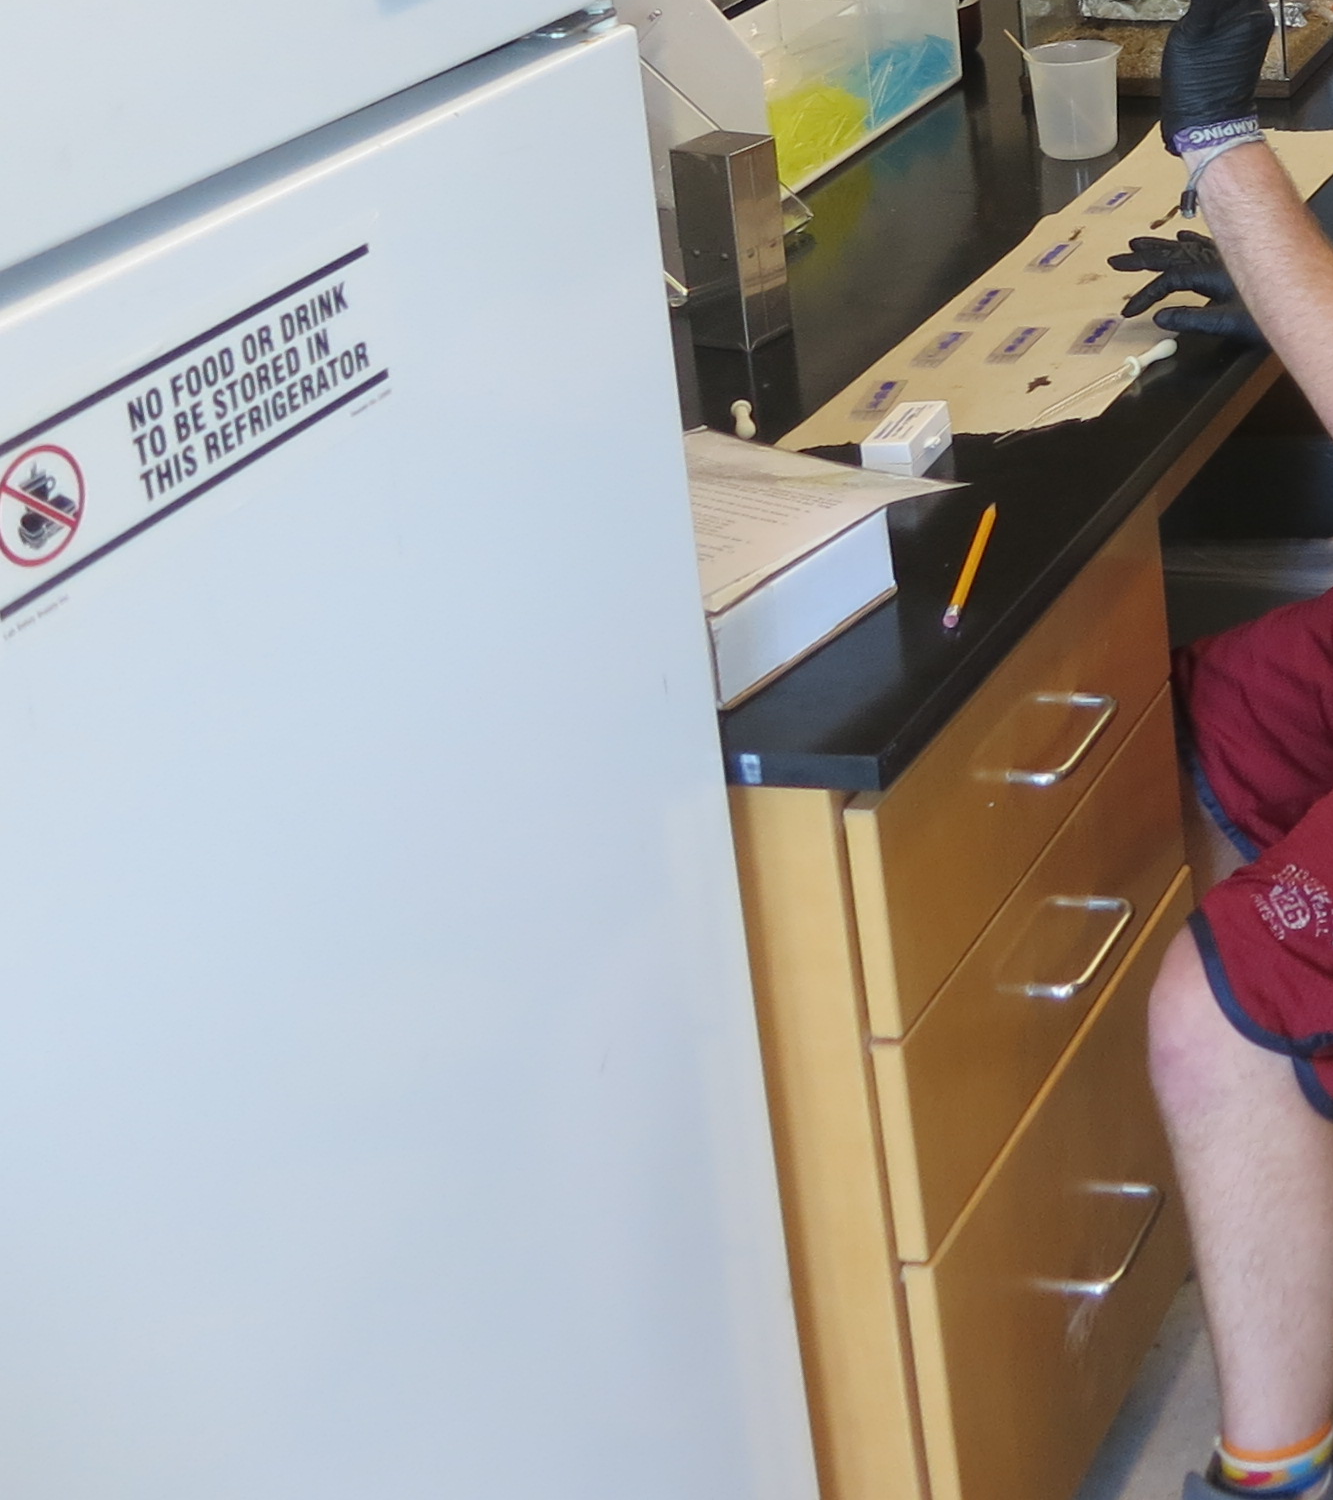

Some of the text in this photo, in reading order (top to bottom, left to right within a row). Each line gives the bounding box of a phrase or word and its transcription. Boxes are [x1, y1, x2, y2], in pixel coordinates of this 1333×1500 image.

[127, 281, 350, 432] NO FOOD OR DRINK
[132, 425, 167, 467] TO
[174, 400, 207, 443] BE
[212, 345, 301, 420] STORED
[306, 327, 331, 365] IN
[139, 341, 370, 502] THIS REFRIGERATOR
